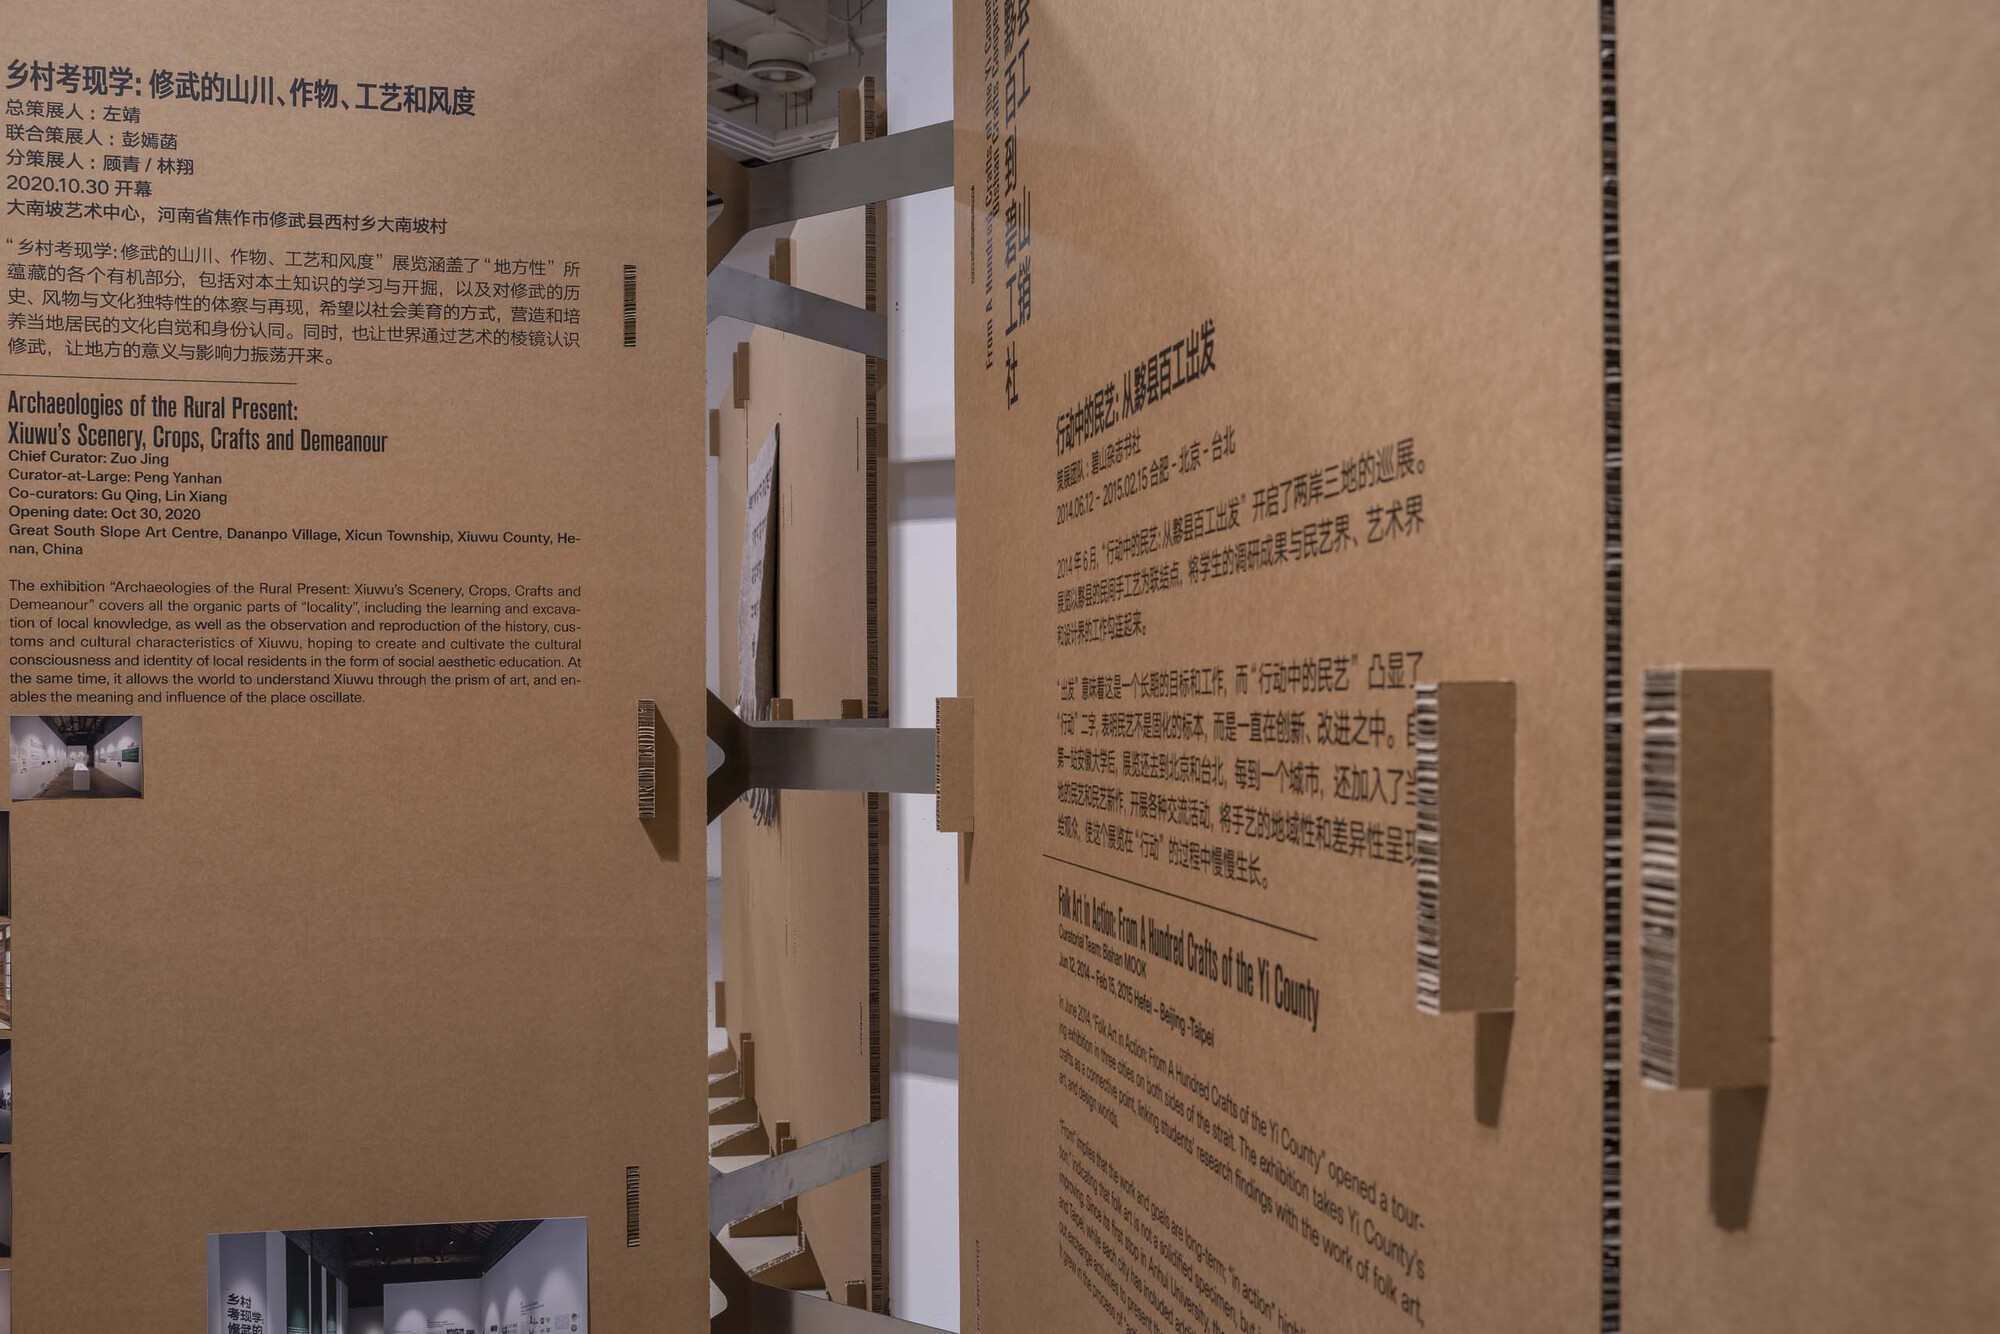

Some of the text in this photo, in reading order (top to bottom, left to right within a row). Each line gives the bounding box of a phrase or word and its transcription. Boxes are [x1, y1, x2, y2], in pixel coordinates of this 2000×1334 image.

[157, 157, 194, 175] 林翔
[6, 175, 153, 198] 2020.10.30 开幕
[7, 389, 298, 422] Archaeologies of the Rural Present:
[7, 420, 388, 453] Xiuwu’s Scenery, Crops, Crafts and Demeanour
[8, 449, 168, 467] Chief Curator: Zuo Jing
[8, 467, 221, 487] Curator-at-Large: Peng Yanhan
[8, 486, 227, 505] Co-curators: Gu Qing, Lin Xiang
[1056, 490, 1093, 525] 2014.06.12
[1102, 465, 1148, 507] 2015.02.15
[8, 504, 200, 523] Opening date: Oct 30, 2020
[8, 523, 580, 545] Great South Slope Art Centre, Dananpo Village, Xicun Township, Xiuwu County, He-
[8, 542, 83, 556] nan, China
[8, 578, 580, 599] The exhibition “Archaeologies of the Rural Present: Xiuwu’s Scenery, Crops, Crafts and
[1058, 923, 1146, 979] Curatorial Team: Bishan MOOK
[1058, 884, 1319, 1033] Folk Art in Action: From A Hundred Crafts of the Yi County
